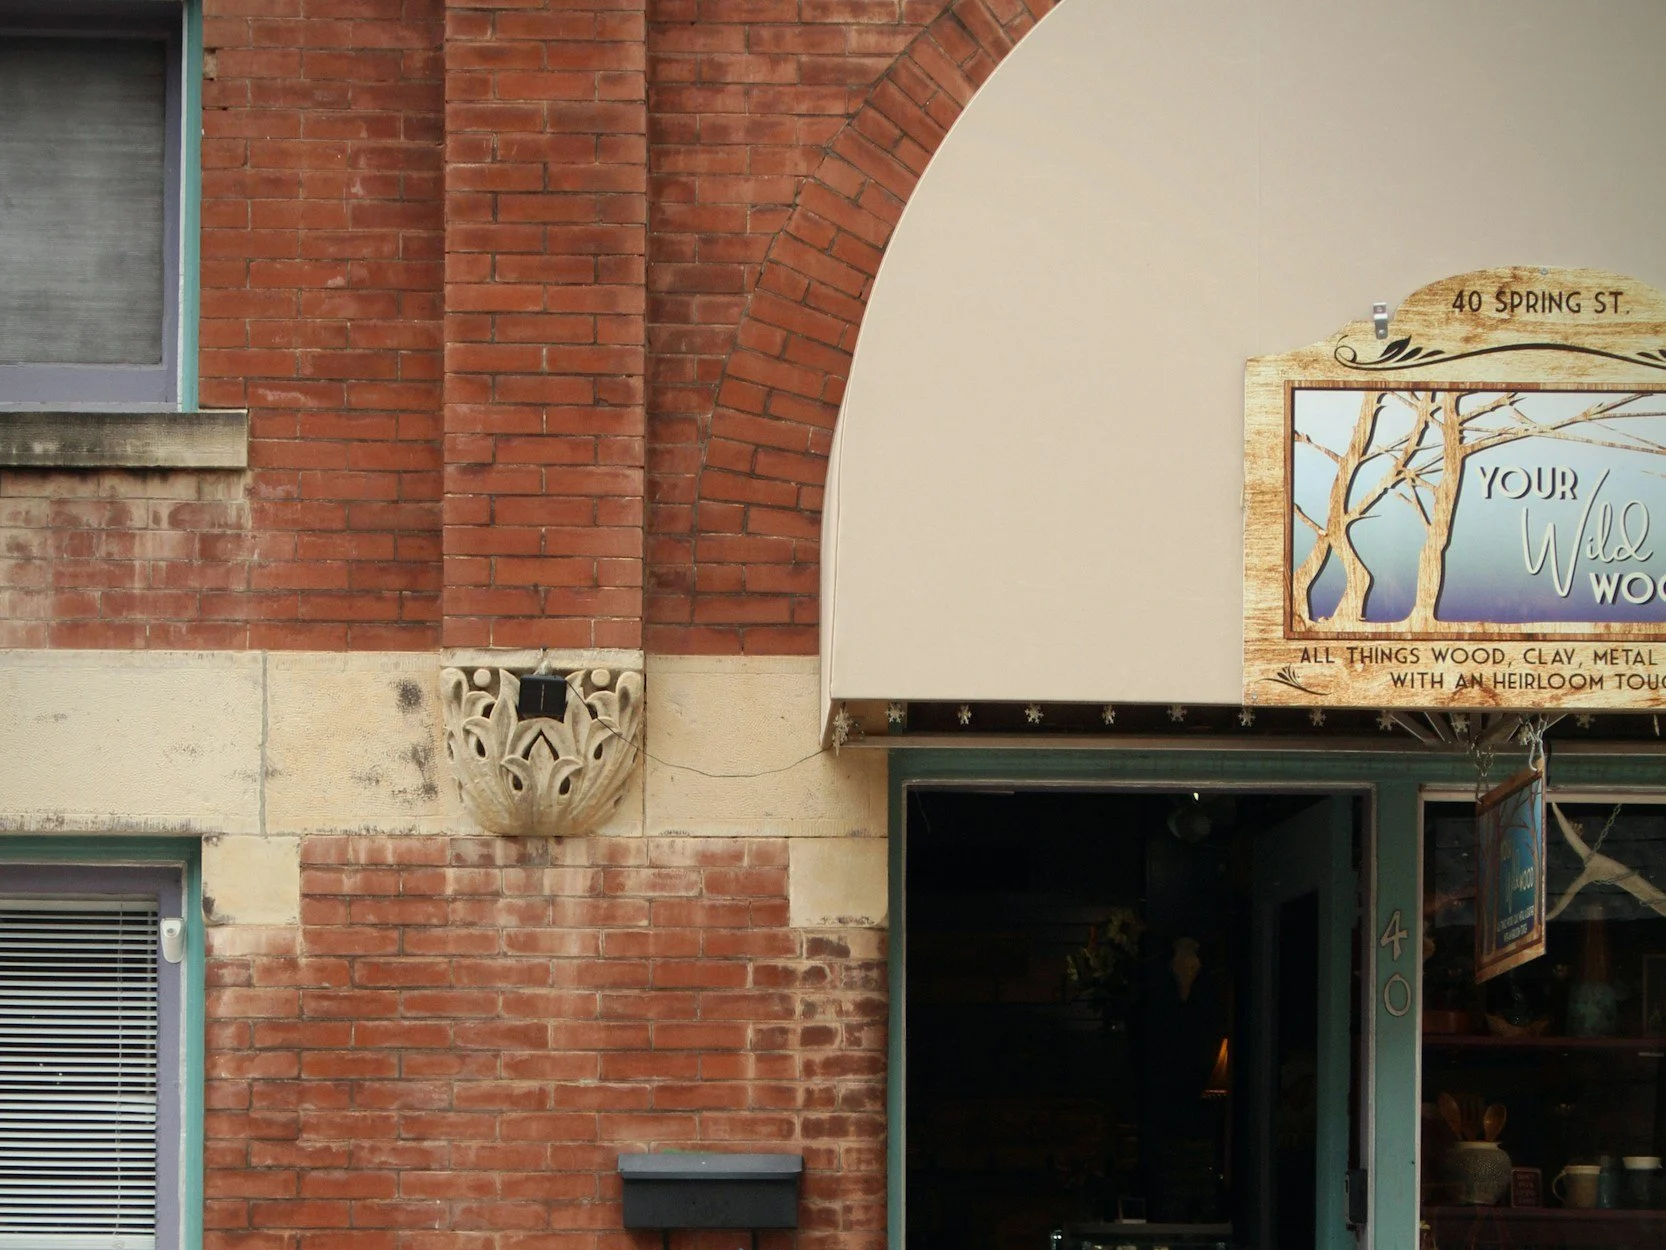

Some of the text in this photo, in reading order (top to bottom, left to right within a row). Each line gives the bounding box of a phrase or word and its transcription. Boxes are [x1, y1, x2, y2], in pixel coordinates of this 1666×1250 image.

[1452, 290, 1631, 315] 40 SPRING ST.
[1478, 466, 1578, 501] YOUR
[1522, 469, 1654, 599] Wild
[1588, 571, 1666, 606] WO
[1300, 647, 1658, 668] ALL THINGS WOOD, CLAY, METAL
[1391, 672, 1444, 689] WITH
[1454, 672, 1484, 690] AN
[1493, 673, 1604, 690] HEIRLOOM
